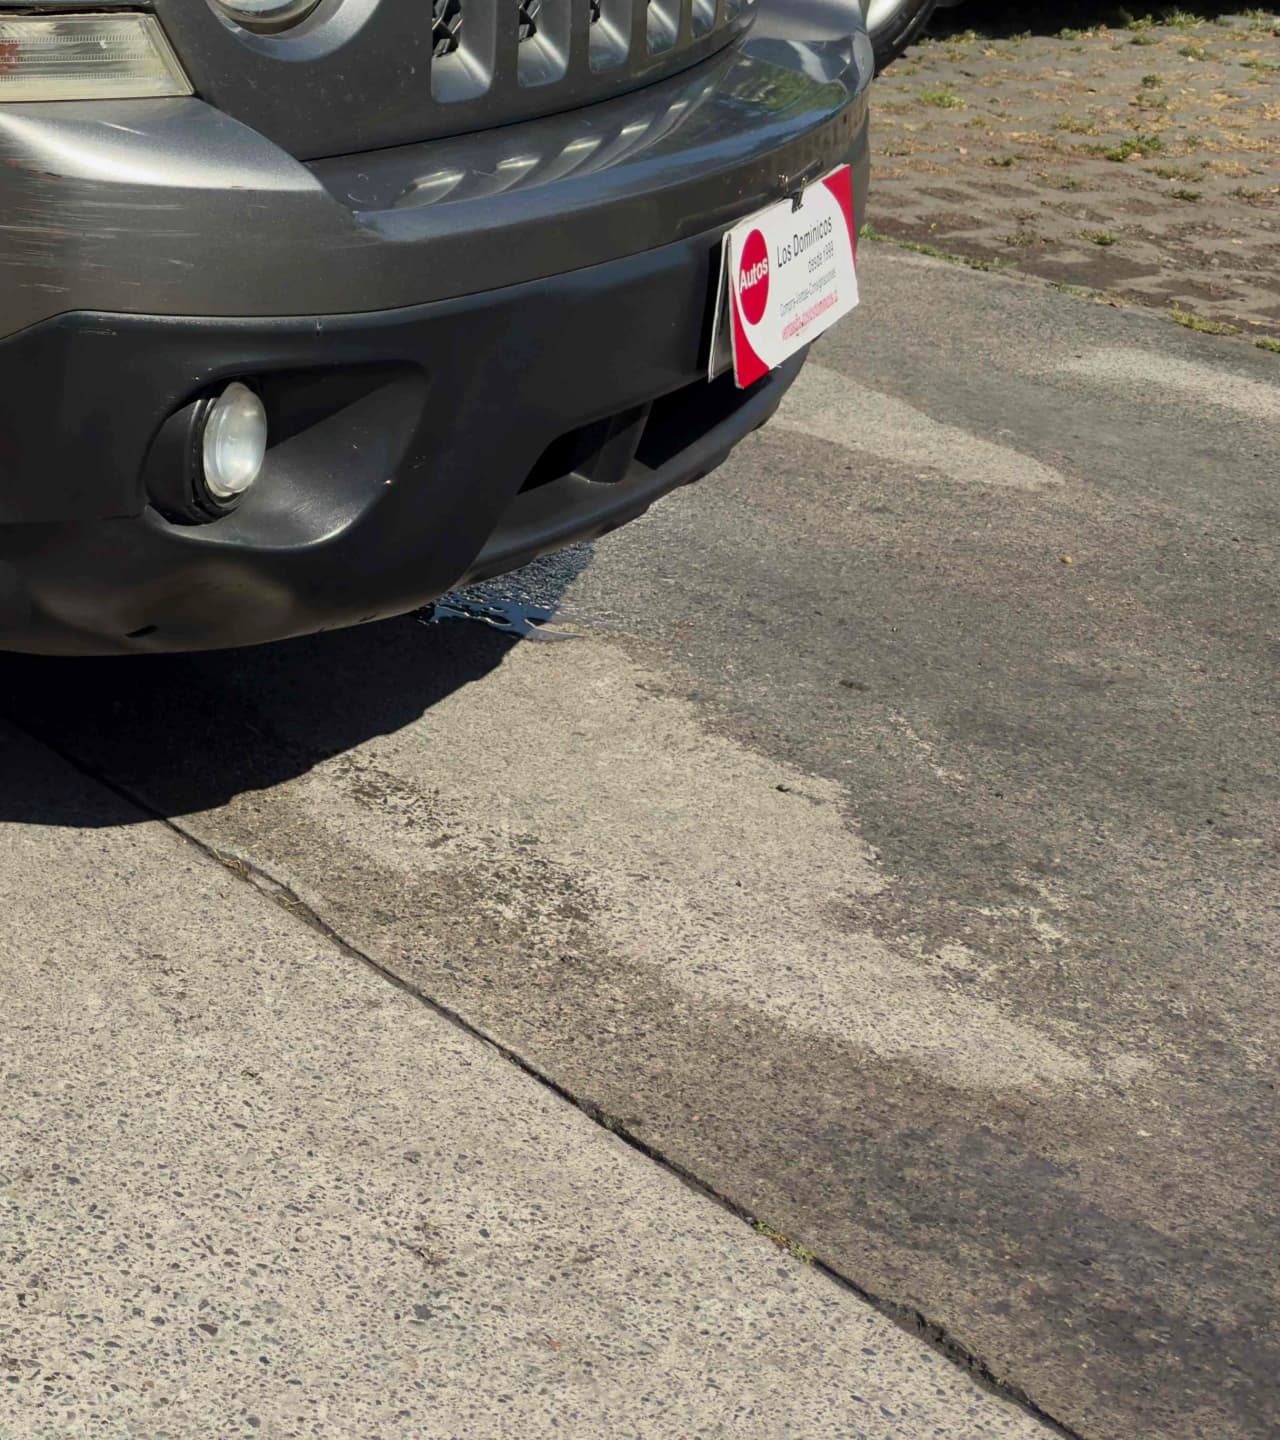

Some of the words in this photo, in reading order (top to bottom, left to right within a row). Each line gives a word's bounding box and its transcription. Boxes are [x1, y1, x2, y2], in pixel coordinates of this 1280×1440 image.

[777, 244, 792, 268] Los
[793, 216, 832, 257] Dominicos
[739, 258, 768, 294] Autos
